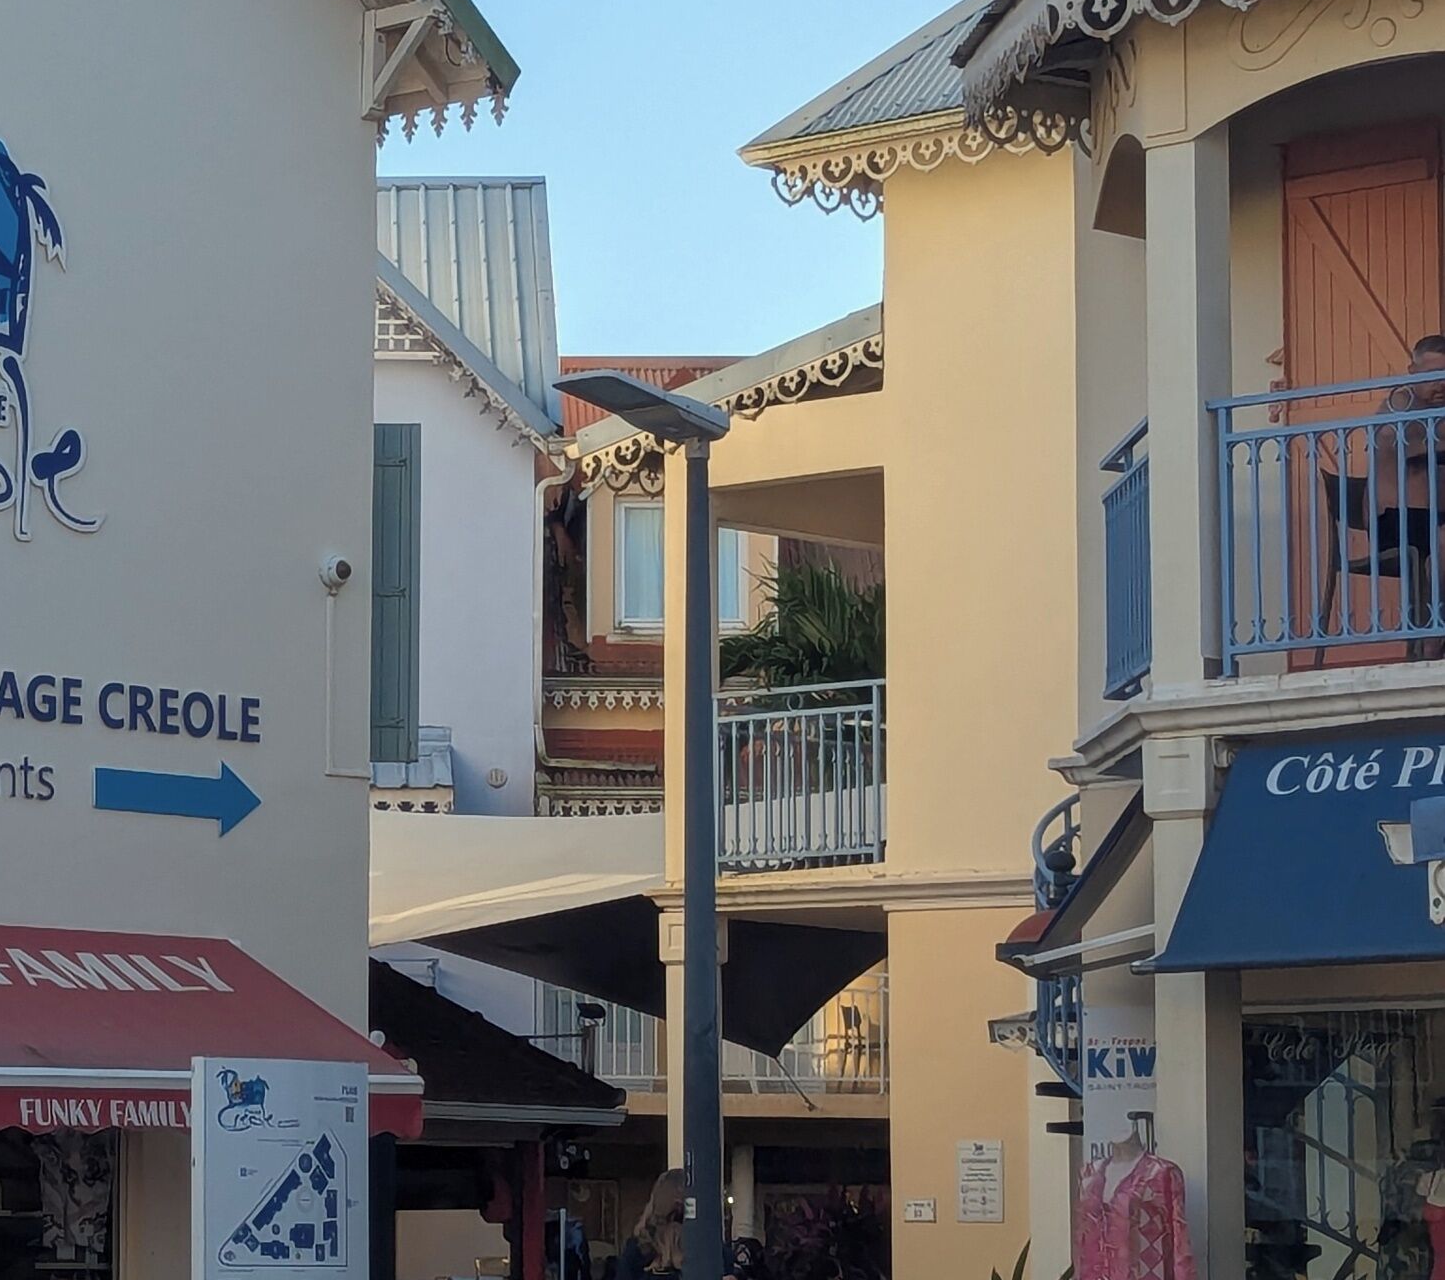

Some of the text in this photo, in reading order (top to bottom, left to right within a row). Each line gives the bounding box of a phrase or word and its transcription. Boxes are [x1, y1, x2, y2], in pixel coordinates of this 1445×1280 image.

[98, 681, 262, 744] CREOLE
[1265, 748, 1384, 796] Côté
[19, 1096, 103, 1127] FUNKY
